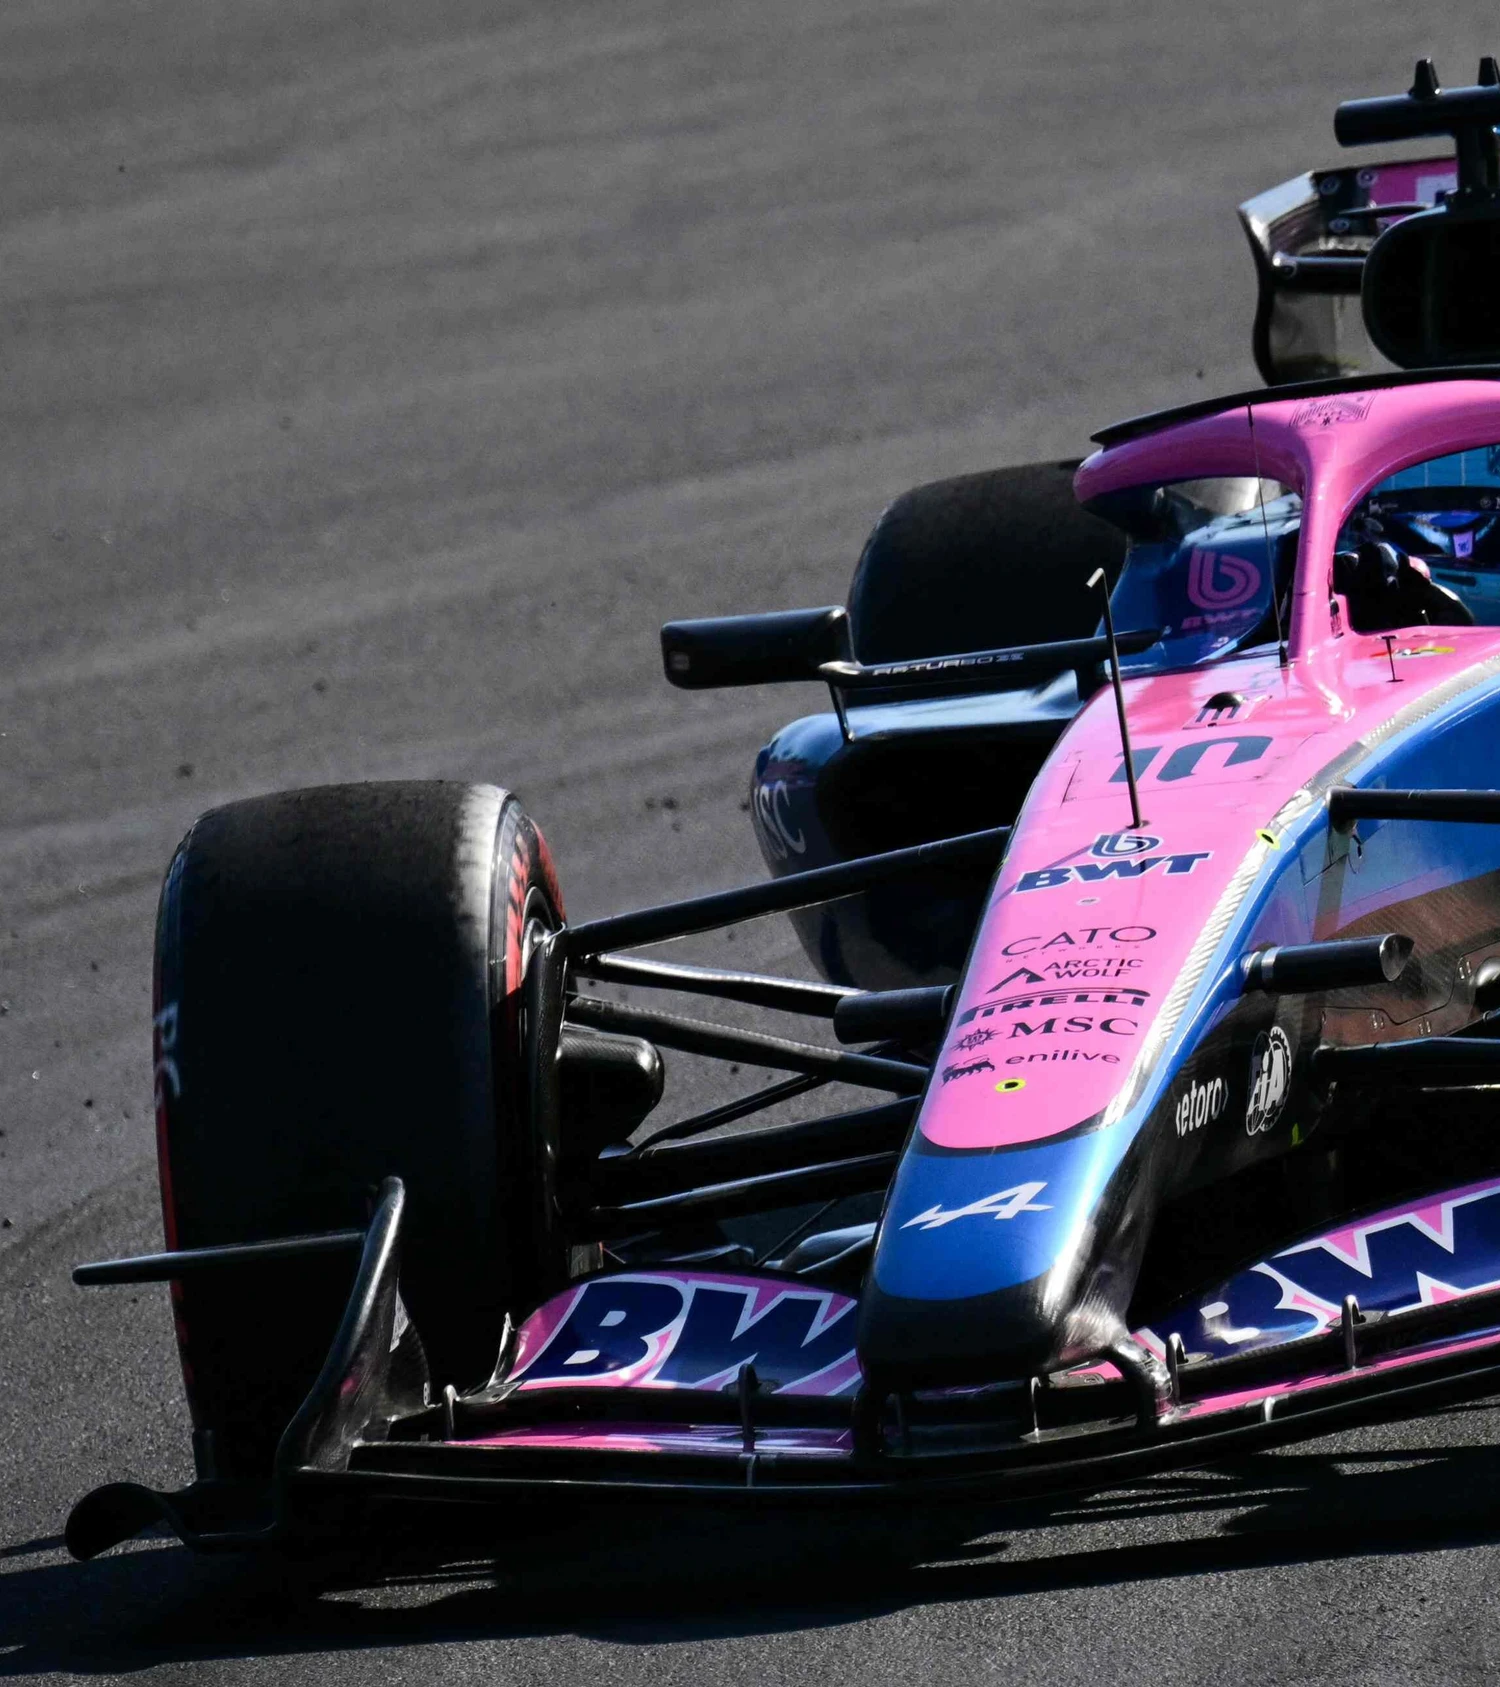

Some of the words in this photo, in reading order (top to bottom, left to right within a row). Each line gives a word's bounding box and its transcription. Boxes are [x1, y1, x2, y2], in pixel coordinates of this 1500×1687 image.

[1012, 851, 1213, 894] BWT
[1001, 926, 1157, 956] CATO
[1043, 958, 1144, 972] ARCTIC
[1054, 968, 1131, 979] WOLF
[956, 987, 1150, 1028] PIRELLI
[1006, 1016, 1139, 1040] MSC
[1005, 1050, 1121, 1065] enilive
[508, 1274, 861, 1397] BW
